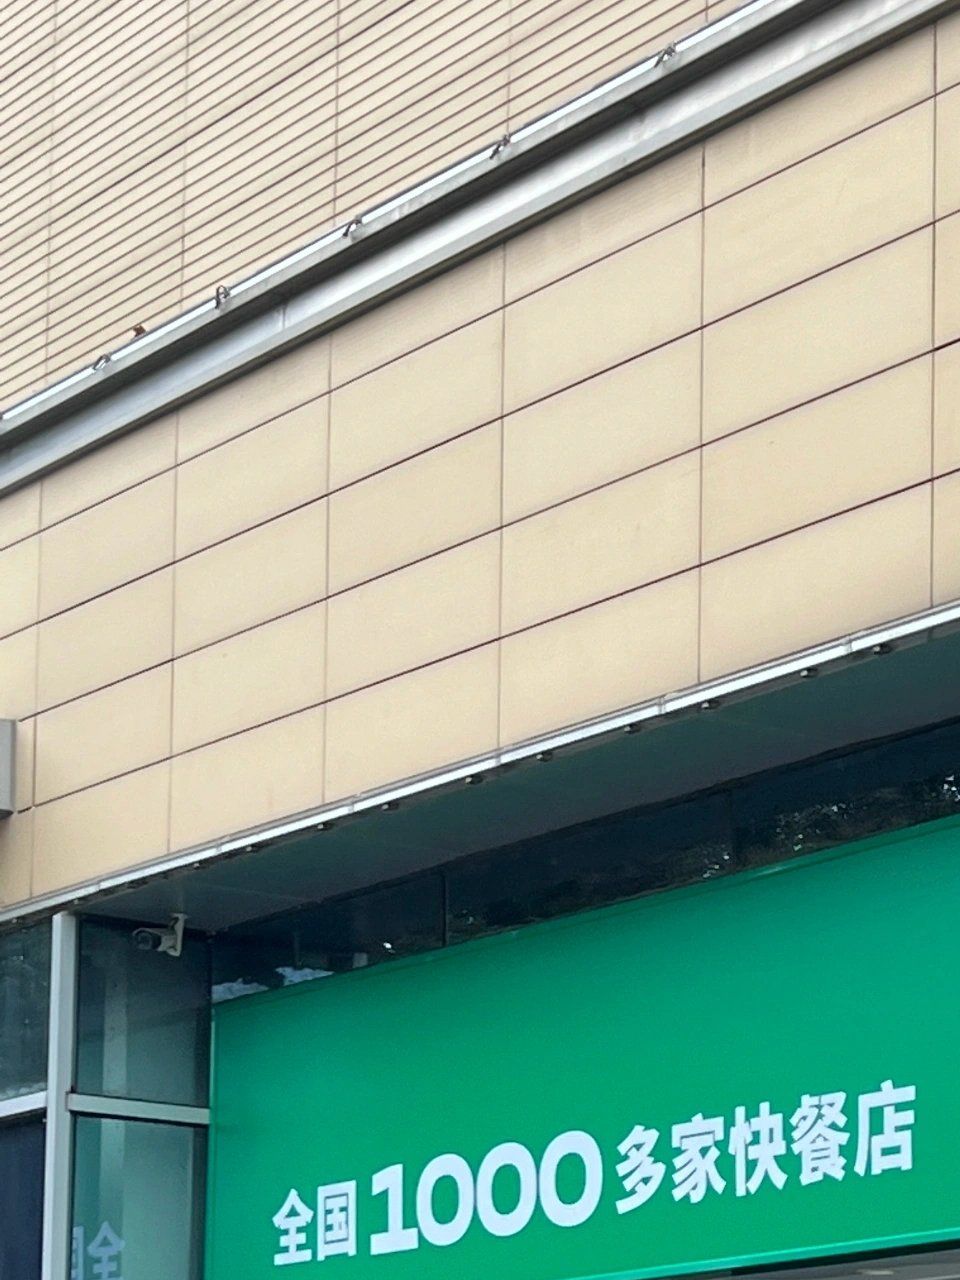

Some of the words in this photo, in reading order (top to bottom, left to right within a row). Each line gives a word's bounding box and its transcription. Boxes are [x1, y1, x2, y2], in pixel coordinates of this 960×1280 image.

[271, 1080, 918, 1267] 全国1000多家快餐店
